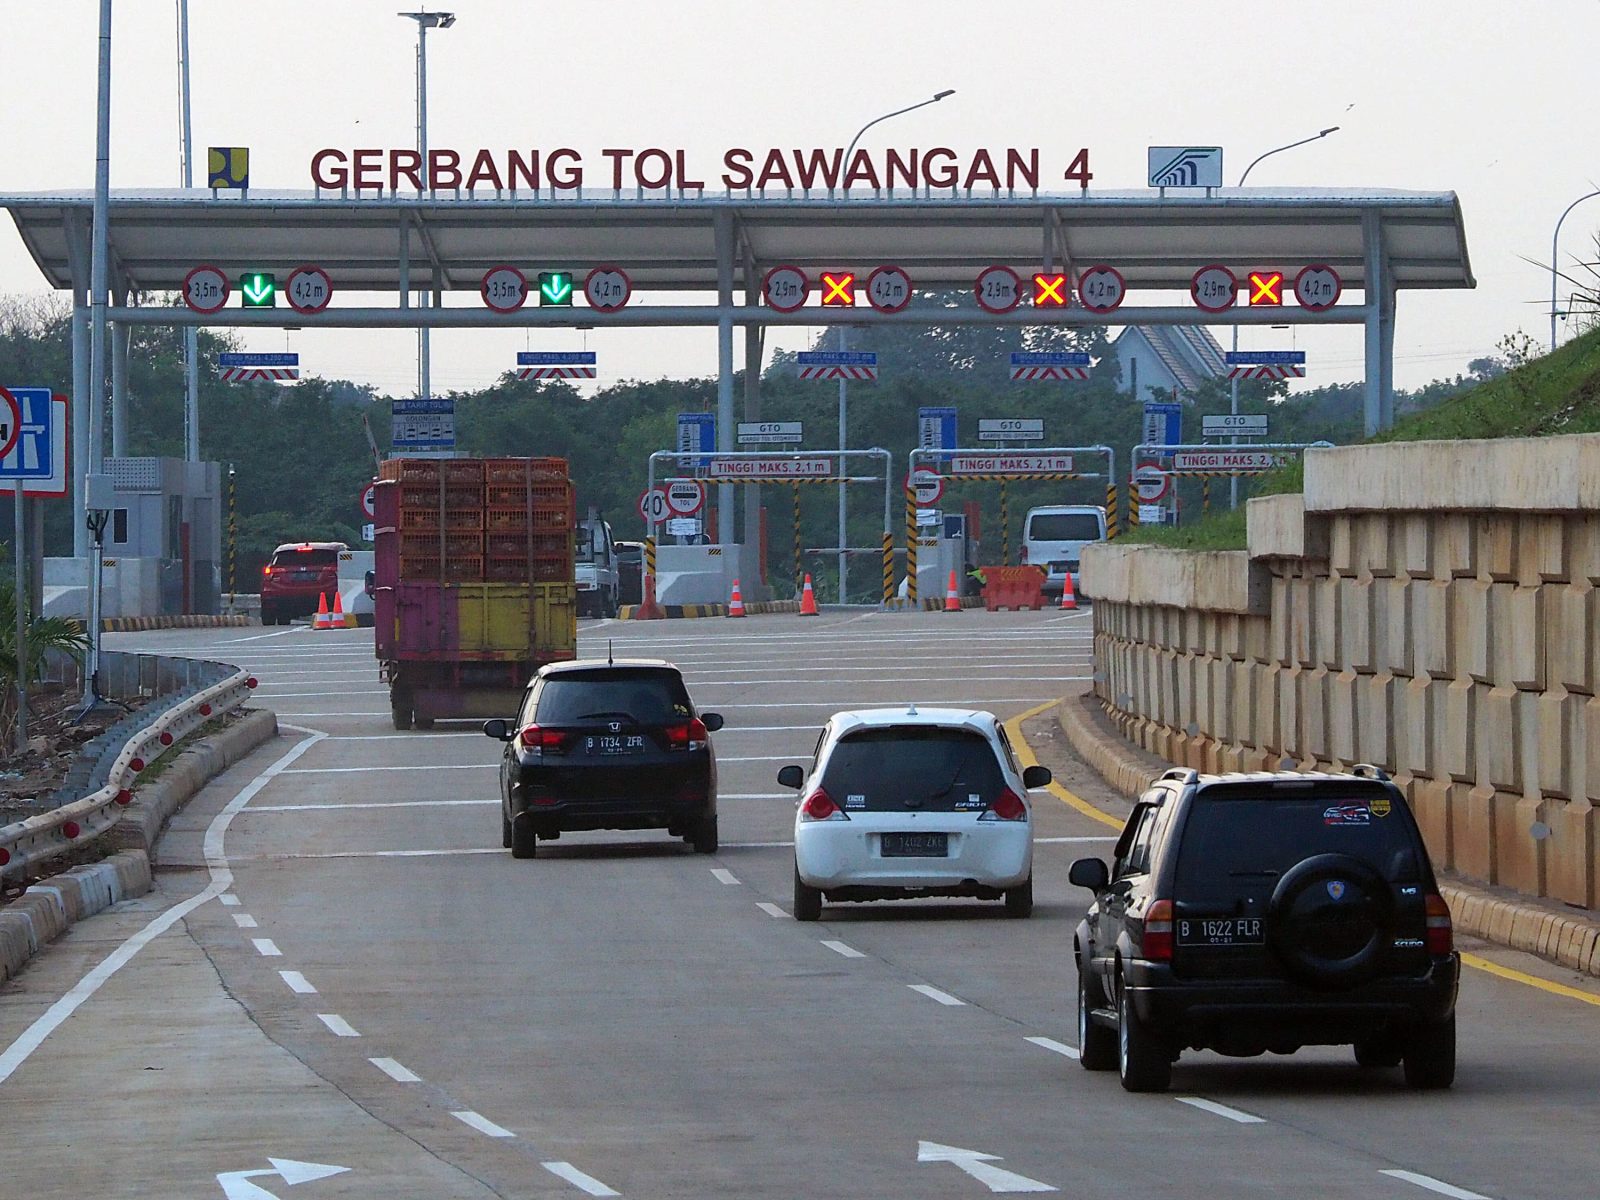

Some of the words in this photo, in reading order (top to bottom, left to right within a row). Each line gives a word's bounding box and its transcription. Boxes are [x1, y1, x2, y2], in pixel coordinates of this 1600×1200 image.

[311, 148, 583, 190] GERBANG
[602, 148, 704, 190] TOL
[722, 147, 1039, 189] SAWANGAN
[1064, 148, 1093, 189] 4
[1001, 421, 1021, 429] GTO
[1225, 417, 1246, 425] GTO
[760, 424, 781, 432] GTO
[959, 460, 995, 470] TINGGI
[1000, 459, 1032, 469] MAKS.
[1037, 459, 1052, 470] 2,1
[1056, 461, 1066, 469] m
[1182, 456, 1219, 465] TINGGI
[1223, 455, 1256, 465] MAKS.
[718, 463, 754, 473] TINGGI
[759, 462, 791, 472] MAKS.
[795, 462, 811, 473] 2,1
[643, 495, 662, 516] 40
[587, 737, 594, 748] B
[627, 736, 643, 747] ZFR
[1181, 921, 1190, 937] B
[1202, 920, 1232, 936] 1622
[1237, 920, 1260, 936] FLR
